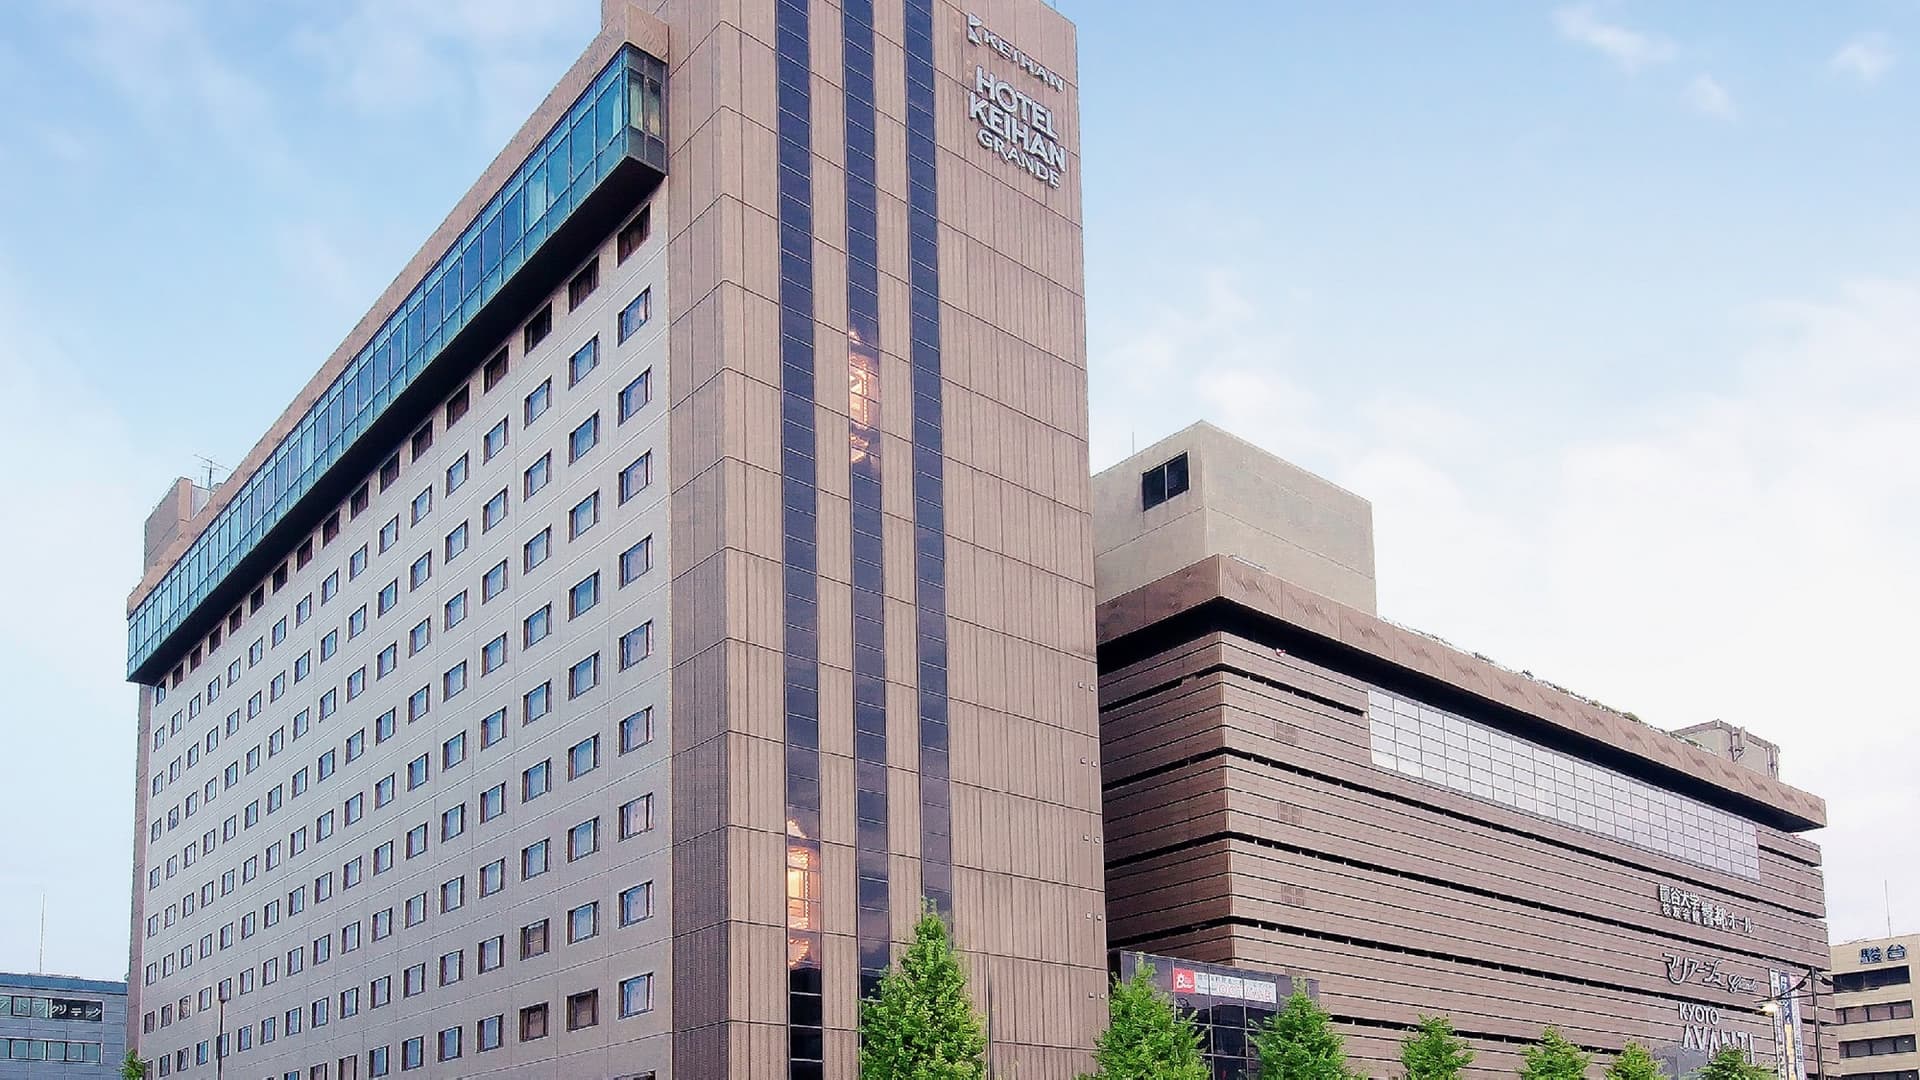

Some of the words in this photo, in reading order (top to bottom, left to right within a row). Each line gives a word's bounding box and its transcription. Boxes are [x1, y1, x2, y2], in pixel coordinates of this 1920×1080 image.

[983, 29, 1065, 93] KEIHAN
[969, 91, 1066, 173] KEIHAN
[975, 65, 1059, 140] HOTEL
[977, 128, 1061, 189] GRANDE
[1859, 944, 1907, 964] 駿台
[1678, 1002, 1720, 1025] KYOTO
